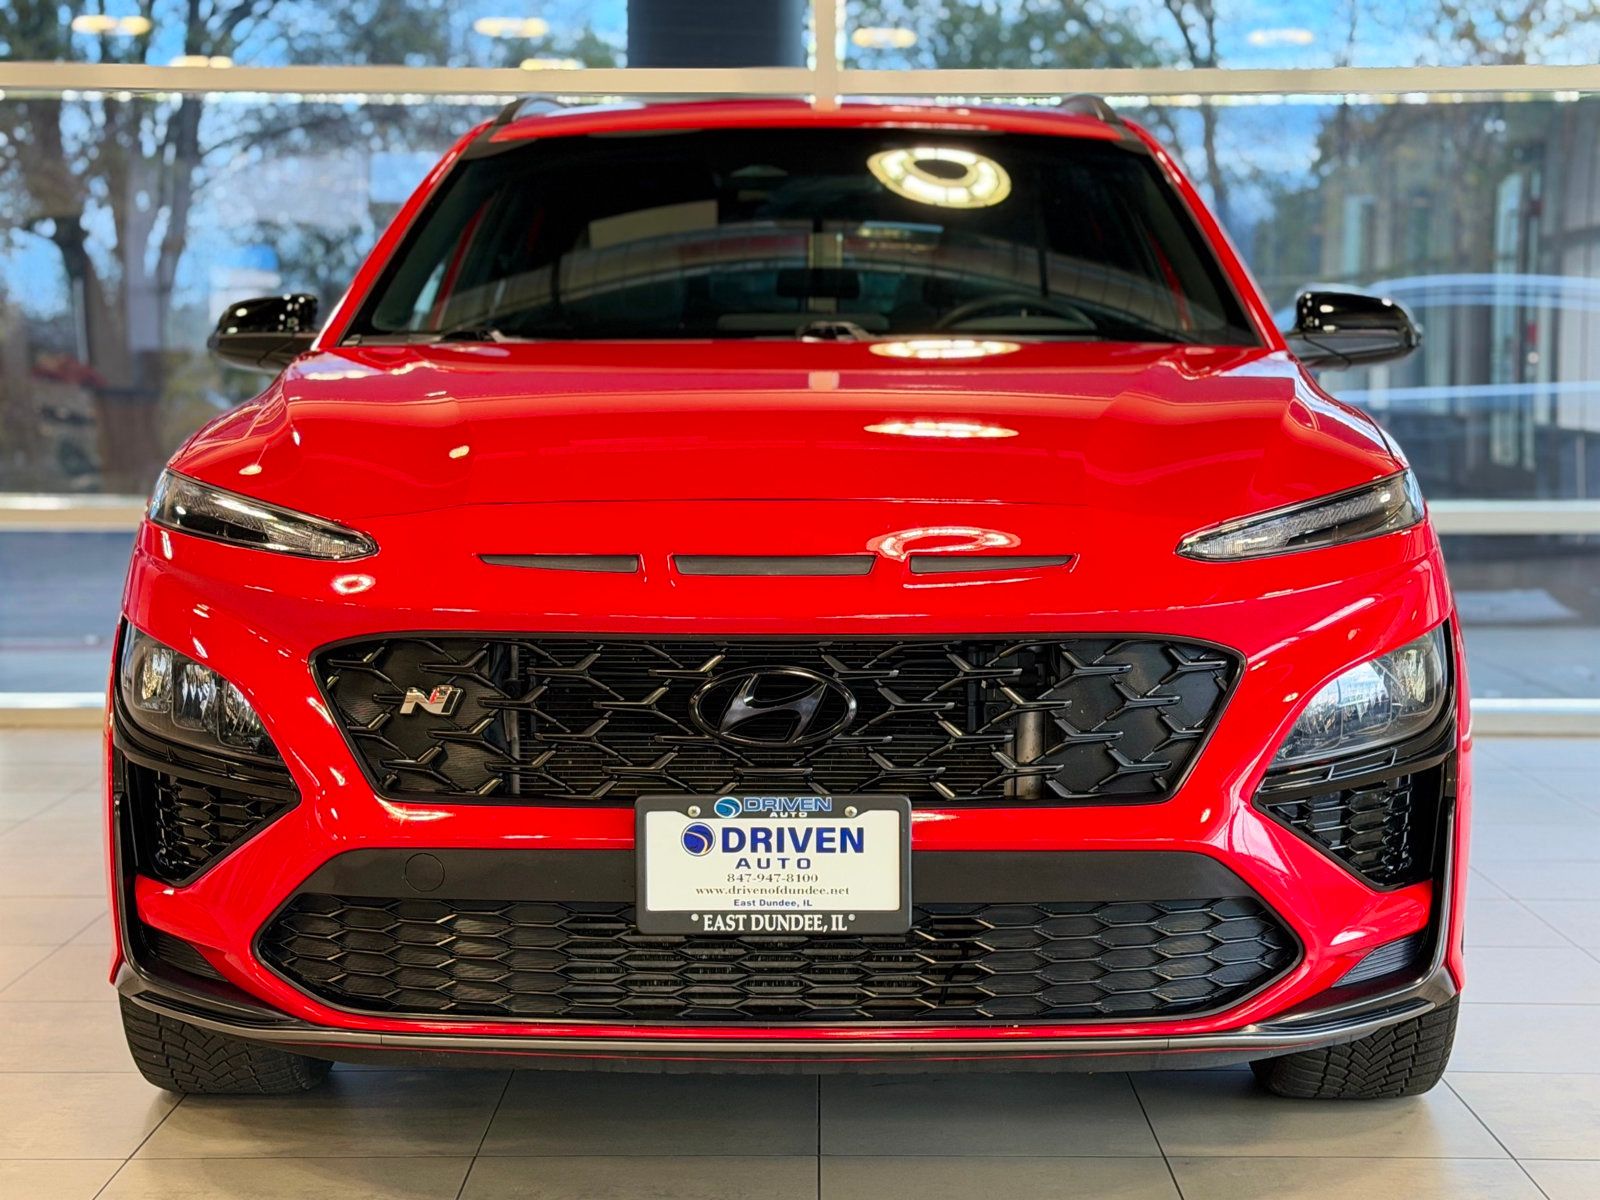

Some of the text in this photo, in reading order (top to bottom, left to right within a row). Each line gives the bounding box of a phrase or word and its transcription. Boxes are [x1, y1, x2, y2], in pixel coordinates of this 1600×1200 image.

[743, 796, 833, 812] DRIVEN
[721, 826, 865, 854] DRIVEN
[735, 857, 811, 870] AUTO
[726, 873, 819, 883] 847-947-8100
[695, 885, 850, 895] www.drivenofdundee.net
[733, 899, 813, 908] East Dundee, IL
[703, 914, 848, 933] EAST DUNDEE, IL
